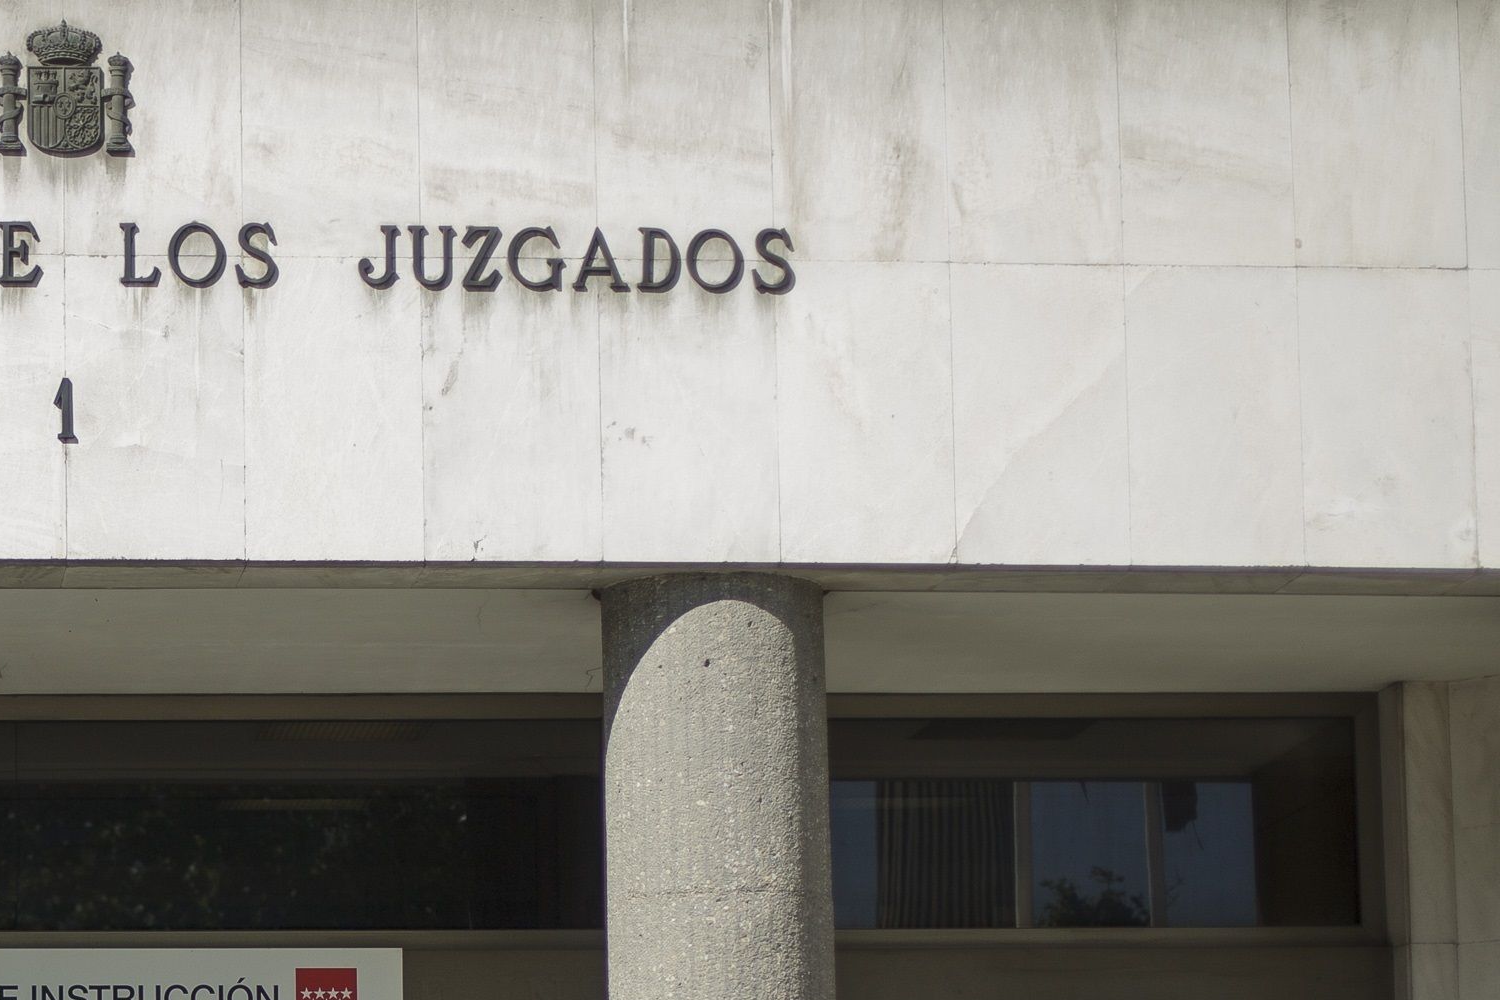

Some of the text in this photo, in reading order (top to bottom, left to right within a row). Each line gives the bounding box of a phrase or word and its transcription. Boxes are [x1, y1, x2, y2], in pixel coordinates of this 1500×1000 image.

[119, 222, 280, 289] LOS
[358, 225, 795, 295] JUZGADOS
[53, 377, 80, 444] 1
